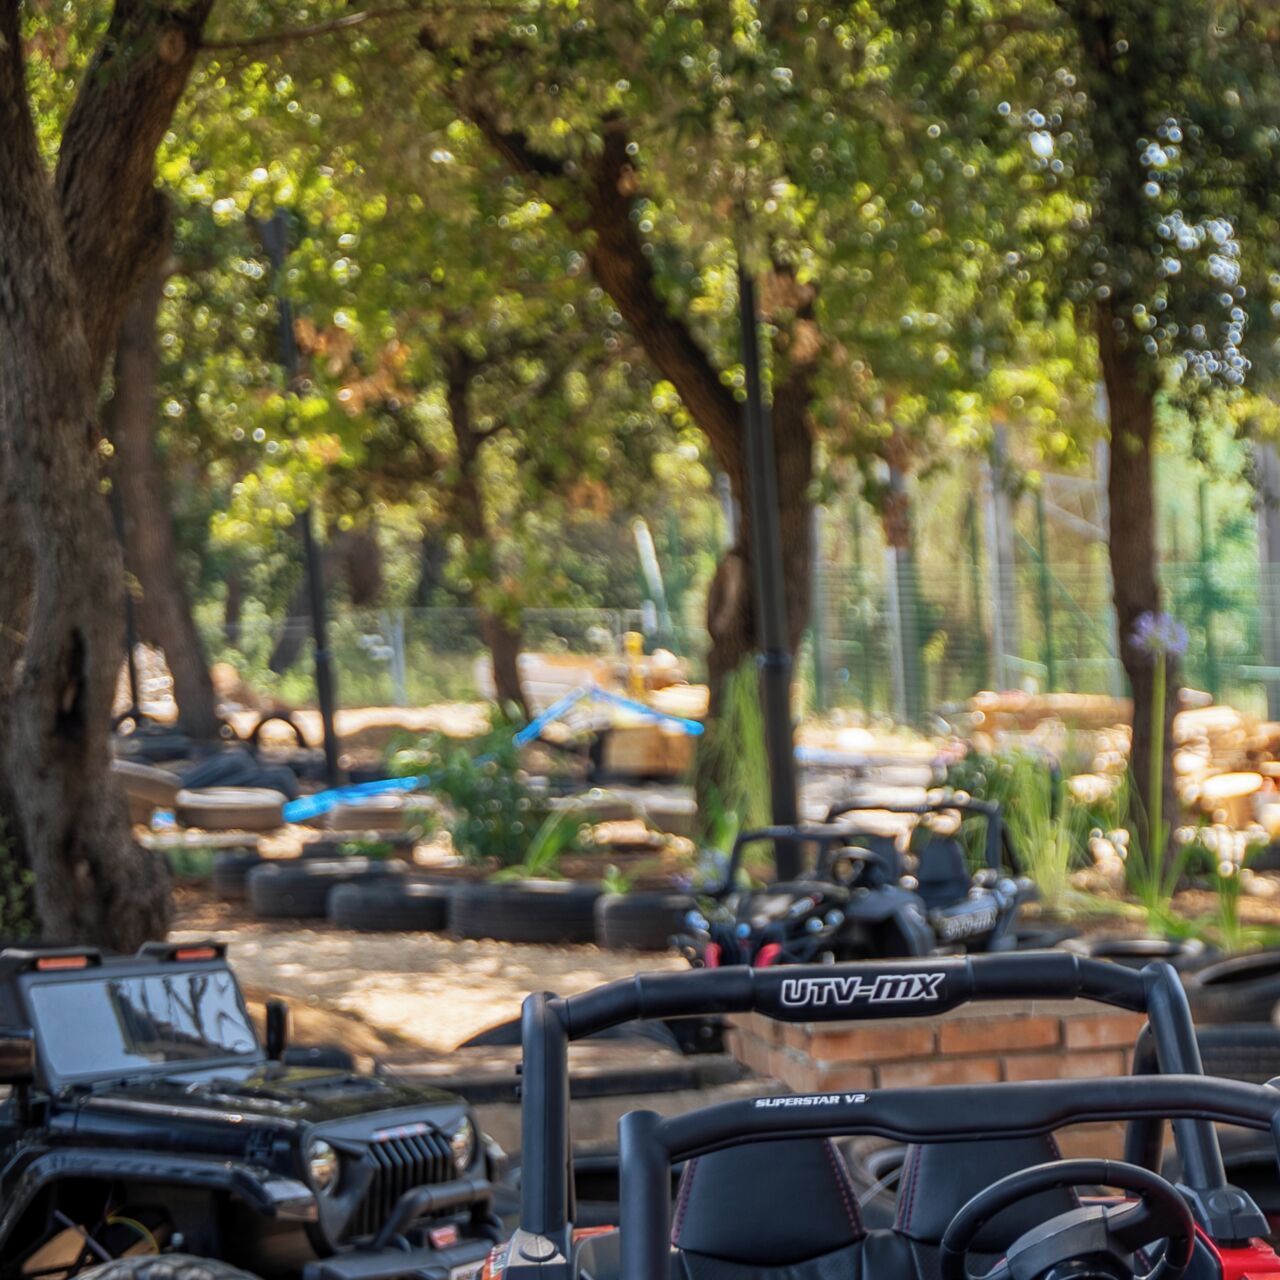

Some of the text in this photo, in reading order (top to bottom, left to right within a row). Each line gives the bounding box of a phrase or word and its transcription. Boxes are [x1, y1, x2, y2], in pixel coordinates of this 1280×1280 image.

[781, 972, 946, 1006] UTV-MX
[755, 1094, 867, 1107] SUPERSTAR V2
